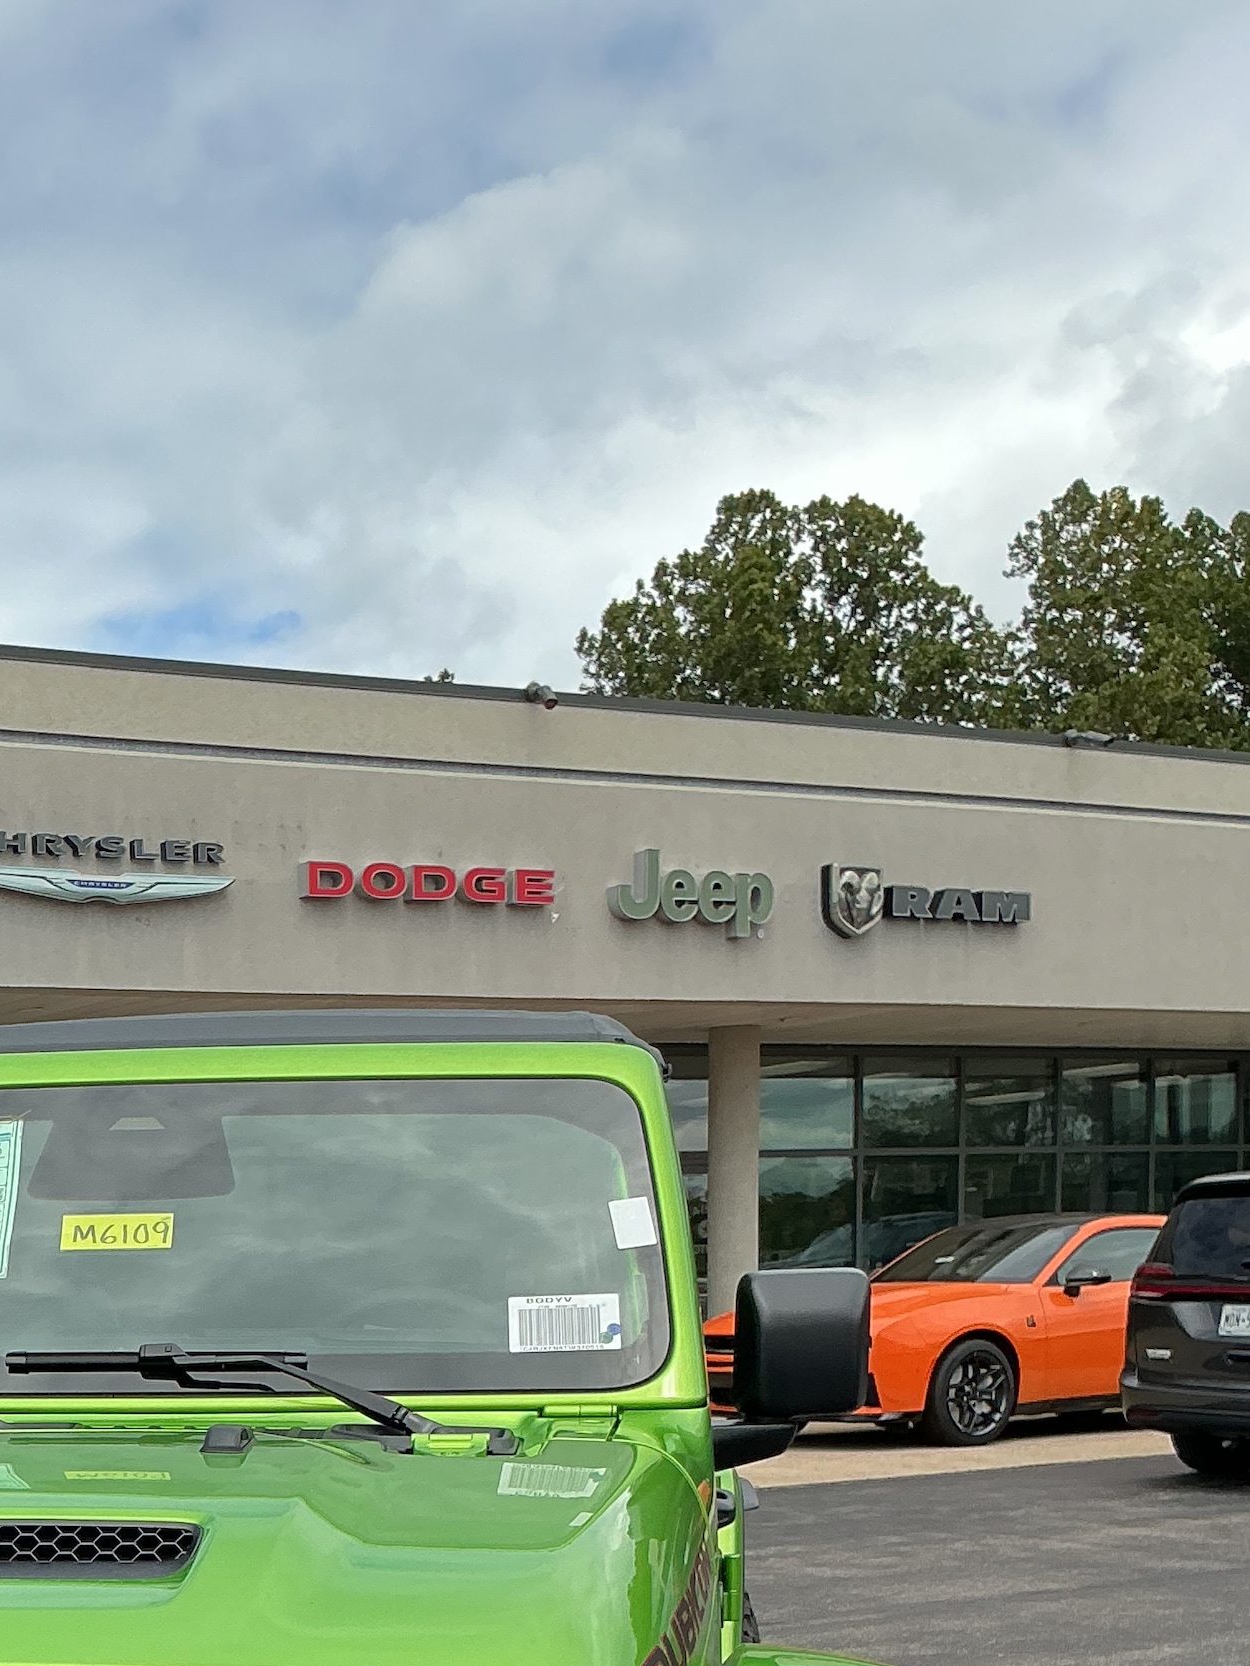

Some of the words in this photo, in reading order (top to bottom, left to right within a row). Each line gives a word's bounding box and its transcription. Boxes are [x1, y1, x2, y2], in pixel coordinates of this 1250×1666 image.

[74, 880, 127, 888] CHRYSLER
[299, 861, 555, 906] DODGE
[607, 849, 773, 938] Jeep
[884, 886, 1032, 924] RAM
[72, 1217, 171, 1244] M6109
